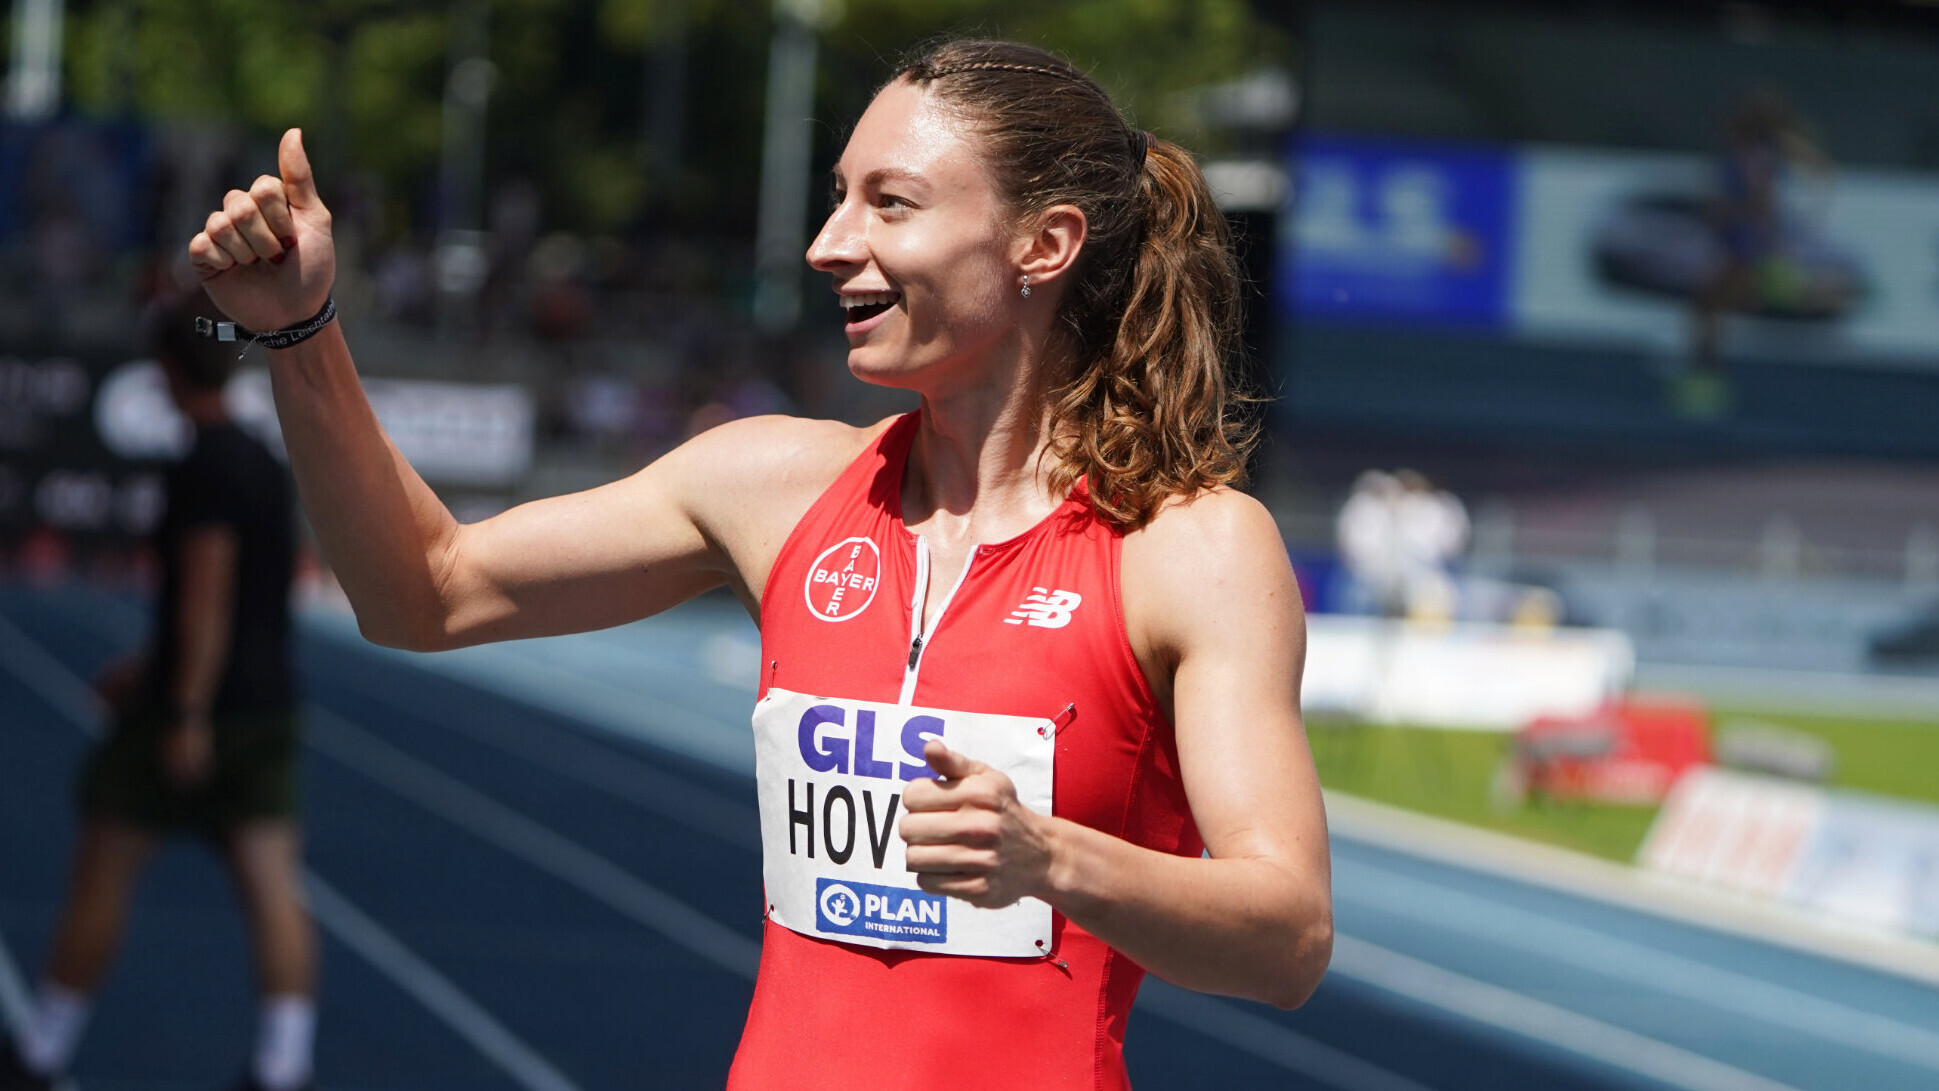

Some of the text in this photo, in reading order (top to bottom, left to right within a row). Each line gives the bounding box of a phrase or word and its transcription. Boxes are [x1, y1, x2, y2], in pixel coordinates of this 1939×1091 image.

[813, 568, 875, 591] BAYER
[825, 545, 862, 615] BAYER
[798, 704, 945, 782] GLS
[788, 778, 908, 872] HOV
[865, 893, 940, 924] PLAN
[865, 921, 941, 937] INTERNATIONAL
